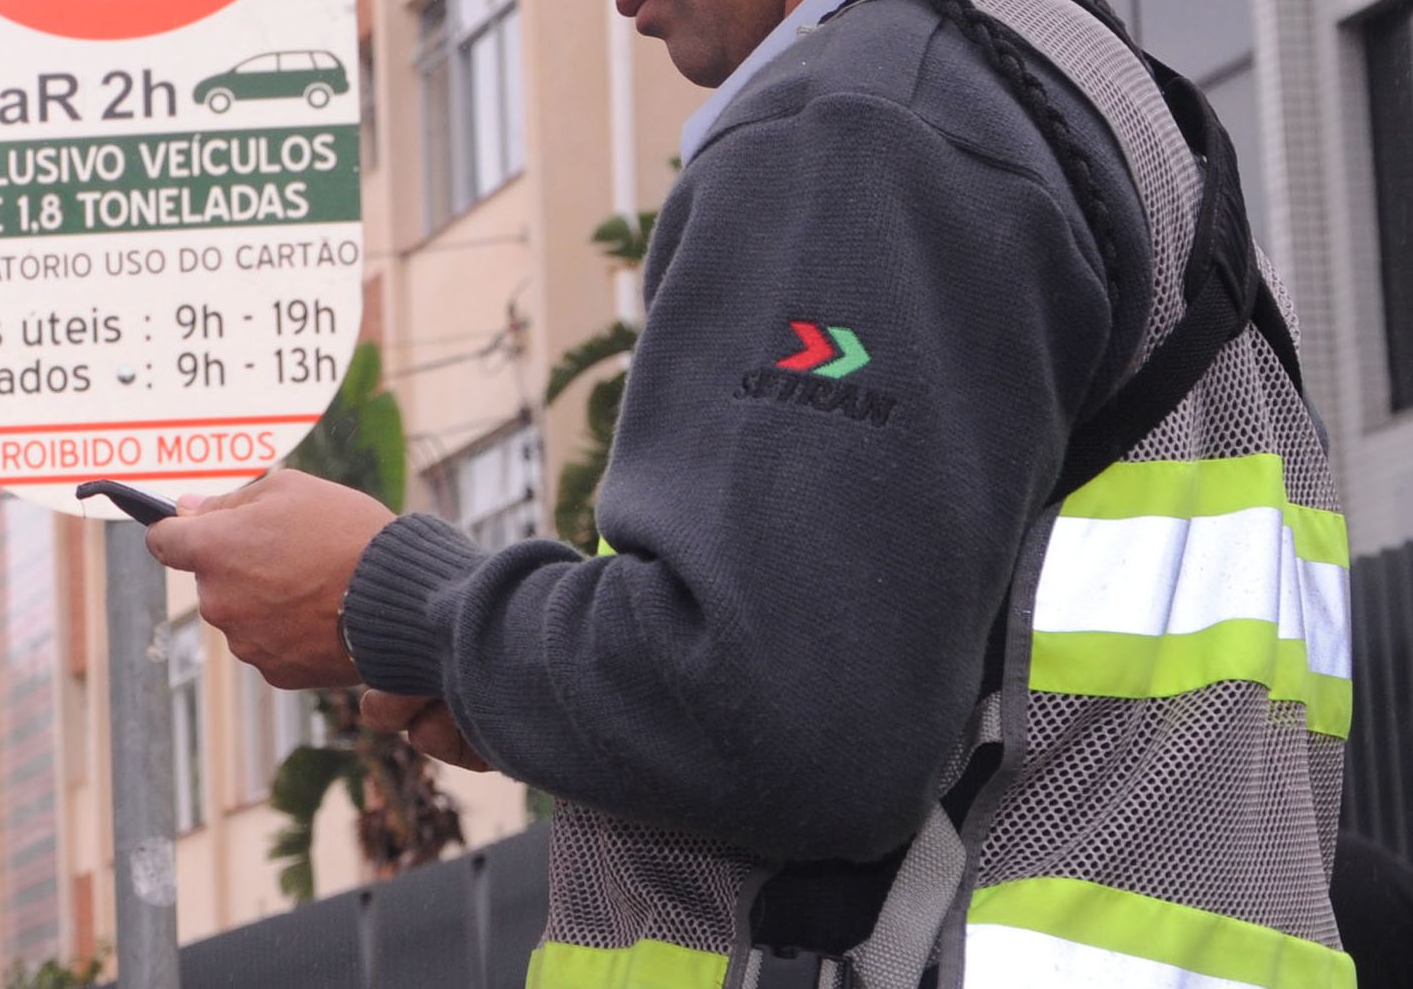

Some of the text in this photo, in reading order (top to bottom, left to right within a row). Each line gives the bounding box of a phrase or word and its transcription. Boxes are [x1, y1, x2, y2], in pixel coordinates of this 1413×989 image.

[102, 69, 176, 120] 2h
[139, 133, 336, 178] VEÍCULOS
[78, 183, 308, 228] TONELADAS
[106, 249, 165, 276] USO
[179, 247, 222, 273] DO
[236, 240, 359, 270] CARTÃO
[23, 308, 121, 346] úteis
[176, 304, 223, 339] 9h
[274, 299, 335, 335] 19h
[177, 352, 224, 387] 9h
[275, 348, 336, 383] 13h
[157, 431, 276, 465] MOTOS
